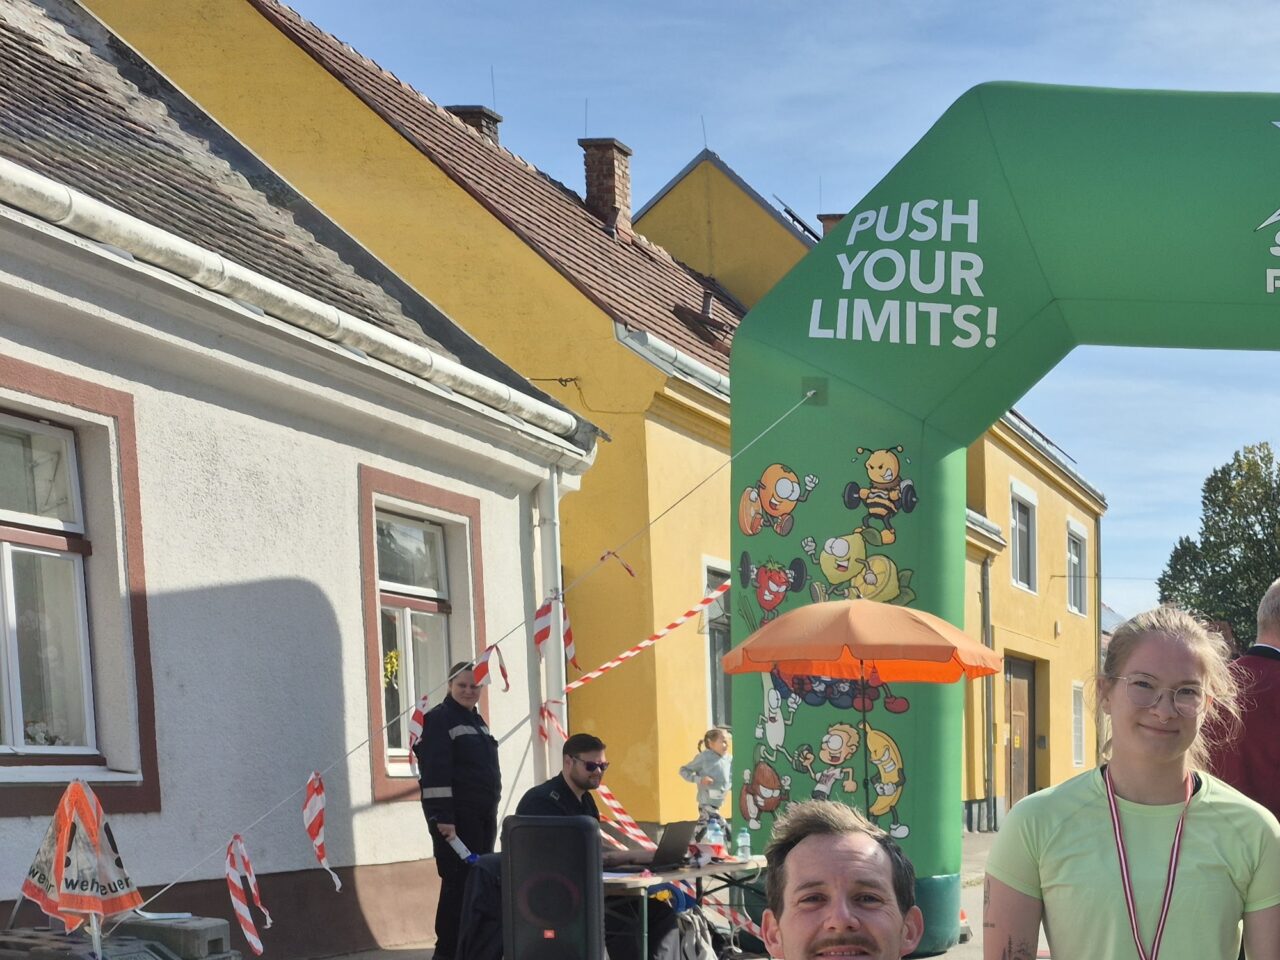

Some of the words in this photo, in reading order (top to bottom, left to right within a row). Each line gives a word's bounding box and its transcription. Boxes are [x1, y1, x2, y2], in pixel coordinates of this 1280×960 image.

[846, 199, 979, 246] PUSH
[836, 248, 985, 298] YOUR
[808, 298, 998, 349] LIMITS!
